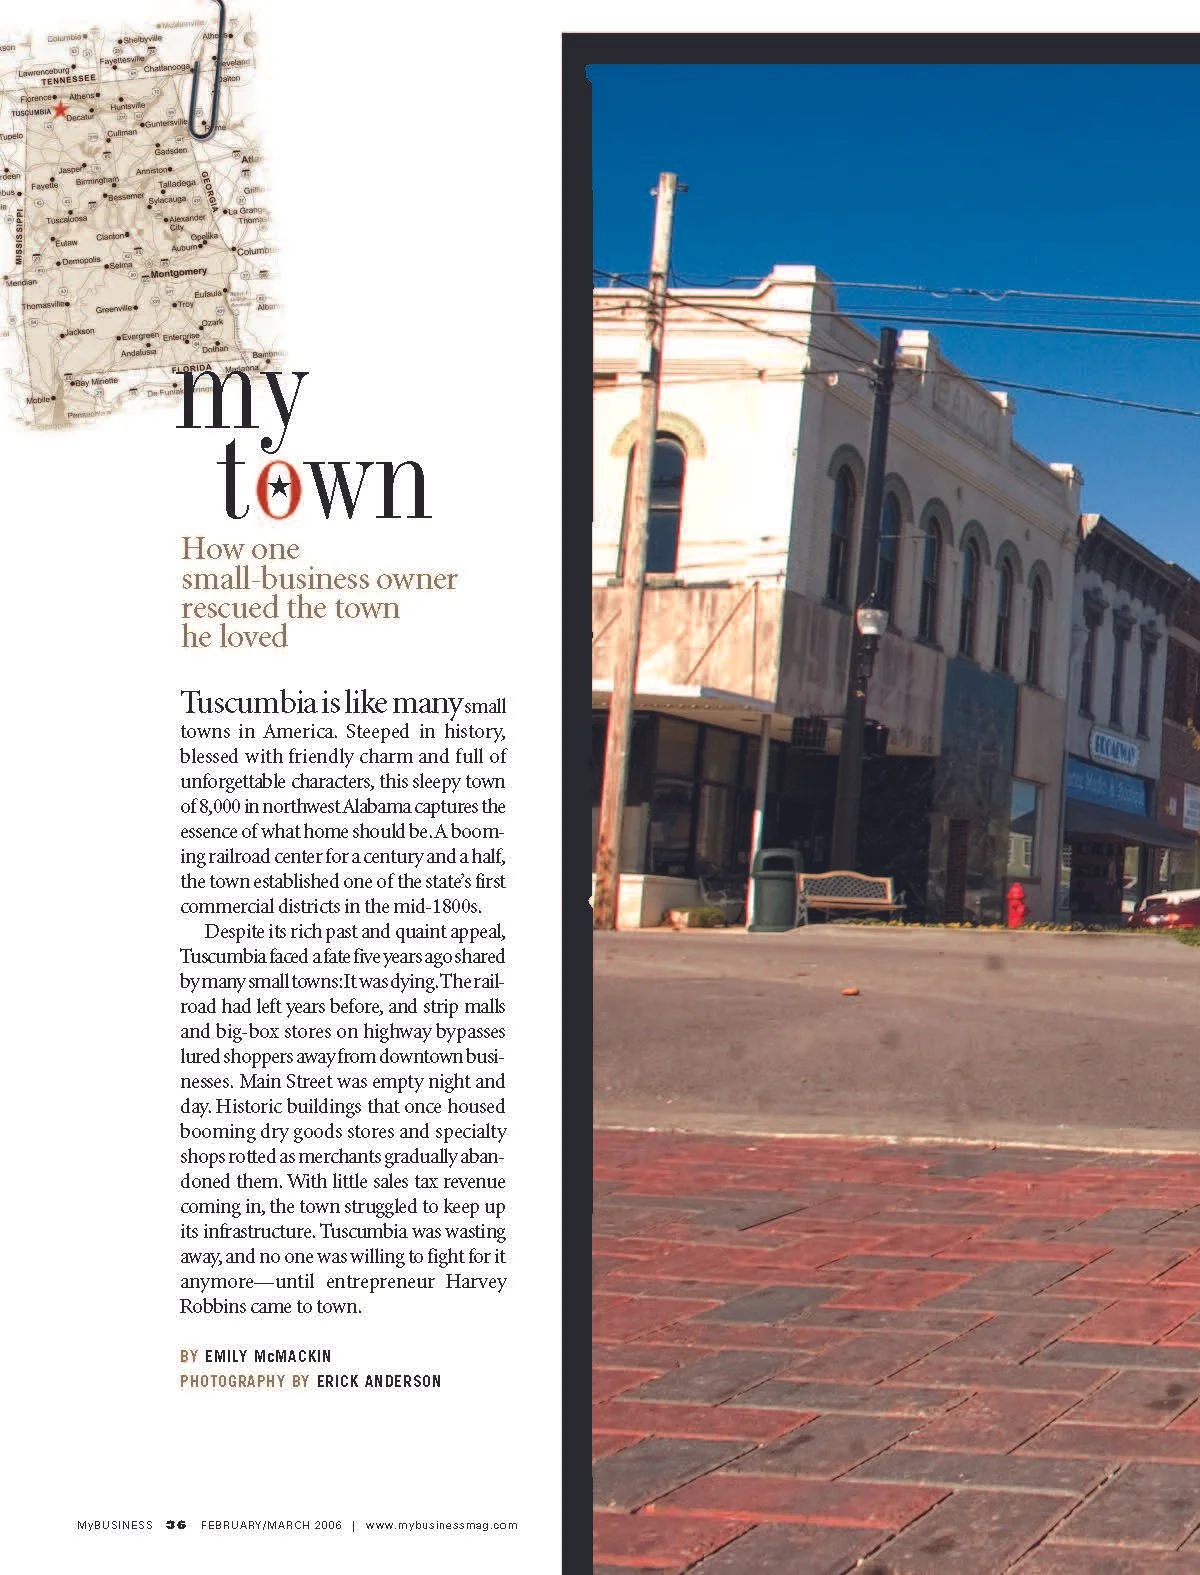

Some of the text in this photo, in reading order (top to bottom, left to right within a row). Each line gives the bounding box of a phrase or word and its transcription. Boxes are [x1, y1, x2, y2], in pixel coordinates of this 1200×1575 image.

[123, 35, 163, 45] Shelbyville
[18, 67, 70, 78] Lawrenceburg
[143, 63, 191, 73] Chattanooga
[41, 74, 96, 86] TENNESSEE
[20, 94, 52, 103] Florence
[69, 92, 95, 100] Athens
[110, 102, 146, 111] Huntsville
[11, 108, 52, 117] TUSCUMBIA
[66, 114, 95, 122] Decatur
[145, 119, 188, 128] Guntersville
[204, 124, 227, 132] Rme
[107, 128, 138, 137] Cullman
[154, 148, 188, 156] Gadsden
[58, 166, 83, 175] Jasper
[135, 166, 168, 175] Anniston
[75, 175, 120, 186] Birmingham
[159, 179, 196, 188] Talladega
[31, 182, 59, 191] Fayette
[107, 192, 144, 201] Bessemer
[201, 171, 219, 213] GEORGIA
[46, 215, 88, 225] Tuscaloosa
[169, 213, 206, 223] Alexander
[170, 224, 185, 232] City
[15, 208, 24, 265] MISSISSIPPI
[96, 233, 125, 241] Clanton
[55, 240, 79, 248] Eutaw
[62, 256, 101, 265] Demopolis
[109, 262, 133, 270] Selma
[151, 266, 207, 280] Montgomery
[22, 301, 66, 310] Thomasville
[95, 304, 133, 314] Greenville
[178, 301, 194, 309] Troy
[201, 319, 224, 327] Ozark
[64, 328, 95, 336] Jackson
[121, 331, 160, 341] Evergreen
[163, 333, 200, 342] Enterprise
[121, 348, 157, 357] Andalusia
[202, 345, 228, 353] Dothan
[171, 364, 212, 374] FLORIDA
[26, 397, 51, 405] Mobile
[935, 374, 991, 436] BANK
[175, 370, 310, 455] my
[216, 438, 433, 520] town
[181, 536, 300, 561] How one
[181, 565, 459, 590] small-business owner
[181, 594, 401, 620] rescued the town
[181, 623, 289, 648] he loved
[181, 689, 506, 721] Tuscumbia is like many small
[181, 723, 505, 743] towns in America. Steeped in history,
[180, 748, 508, 768] blessed with friendly charm and full of
[181, 773, 505, 793] unforgettable characters, this sleepy town
[181, 798, 505, 818] of 8,000 in northwest Alabama captures the
[181, 823, 504, 838] essence of what home should be. A boom-
[181, 1273, 507, 1293] anymore—until entrepreneur Harvey
[180, 1298, 361, 1313] Robbins came to town.
[181, 1350, 330, 1362] BY EMILY McMACKIN
[181, 1375, 440, 1387] PHOTOGRAPHY BY ERICK ANDERSON
[77, 1520, 519, 1532] MyBUSINESS 36 FEBRUARY/MARCH 2006 www.mybusinessmag.com
